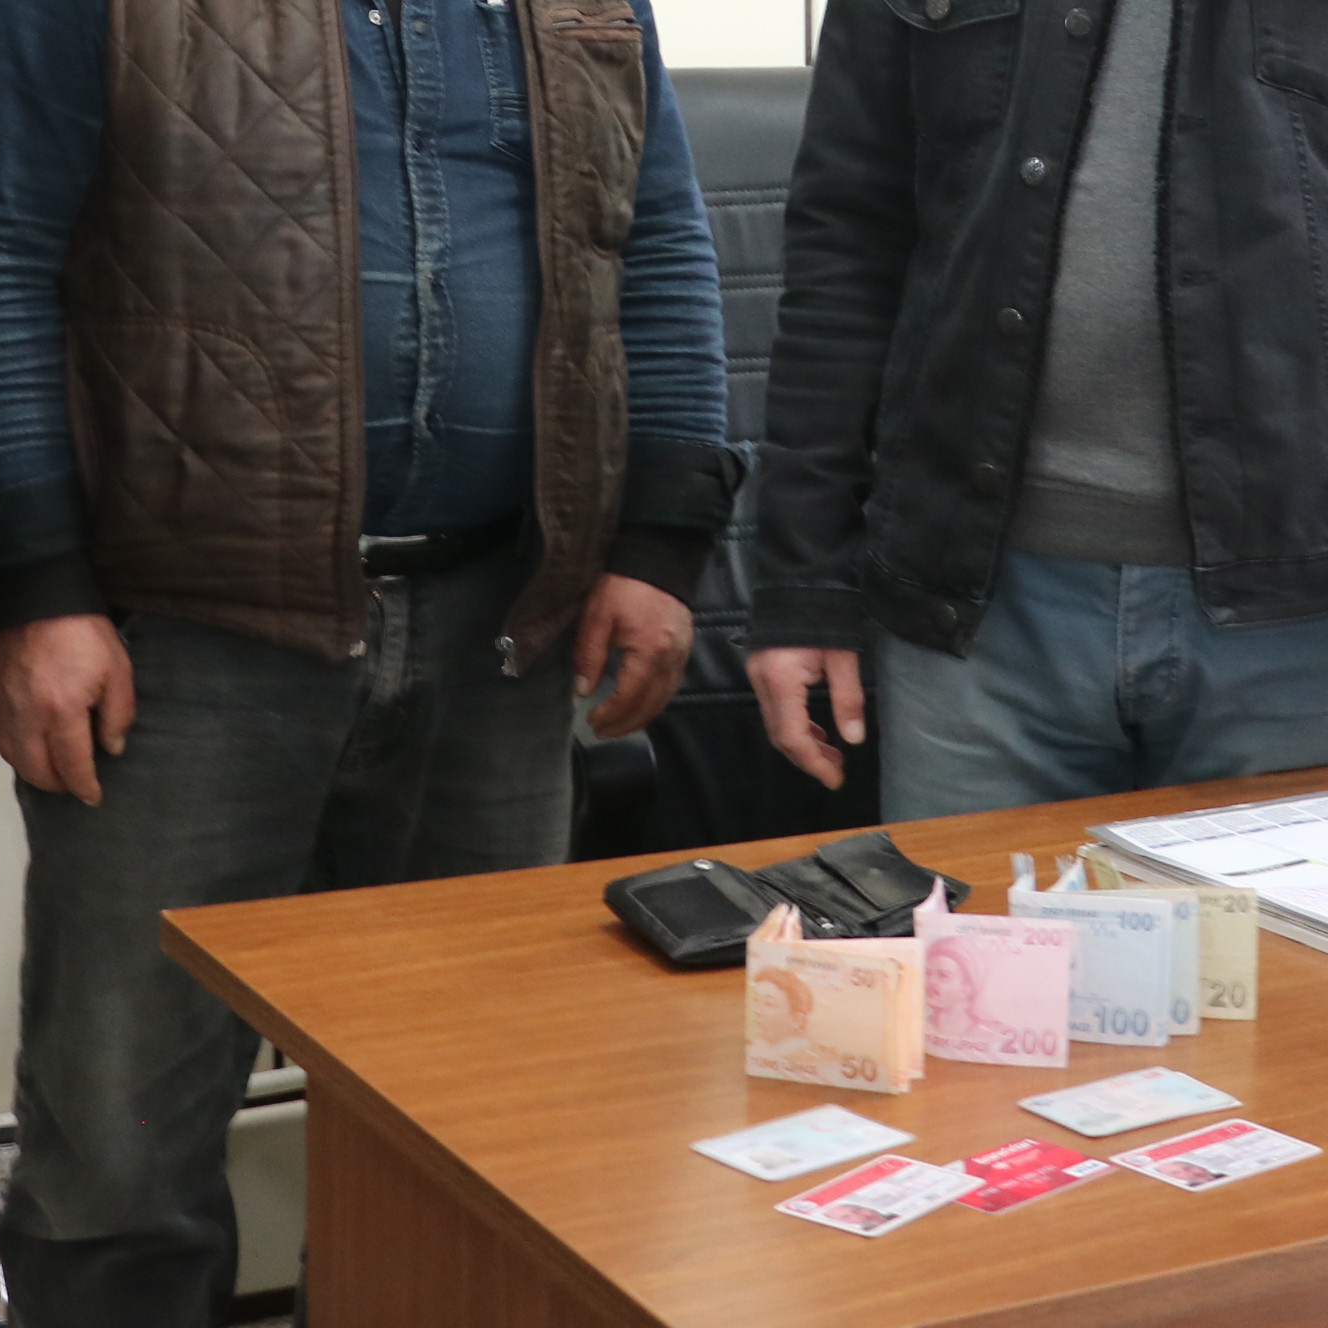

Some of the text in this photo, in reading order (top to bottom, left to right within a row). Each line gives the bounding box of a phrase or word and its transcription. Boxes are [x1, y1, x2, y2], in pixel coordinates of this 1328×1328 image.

[1224, 894, 1251, 914] 20
[1115, 912, 1153, 932] 100
[1024, 927, 1062, 948] 200
[1208, 980, 1247, 1009] 20
[1093, 1005, 1150, 1037] 100
[1000, 1029, 1058, 1057] 200
[840, 1055, 878, 1083] 50
